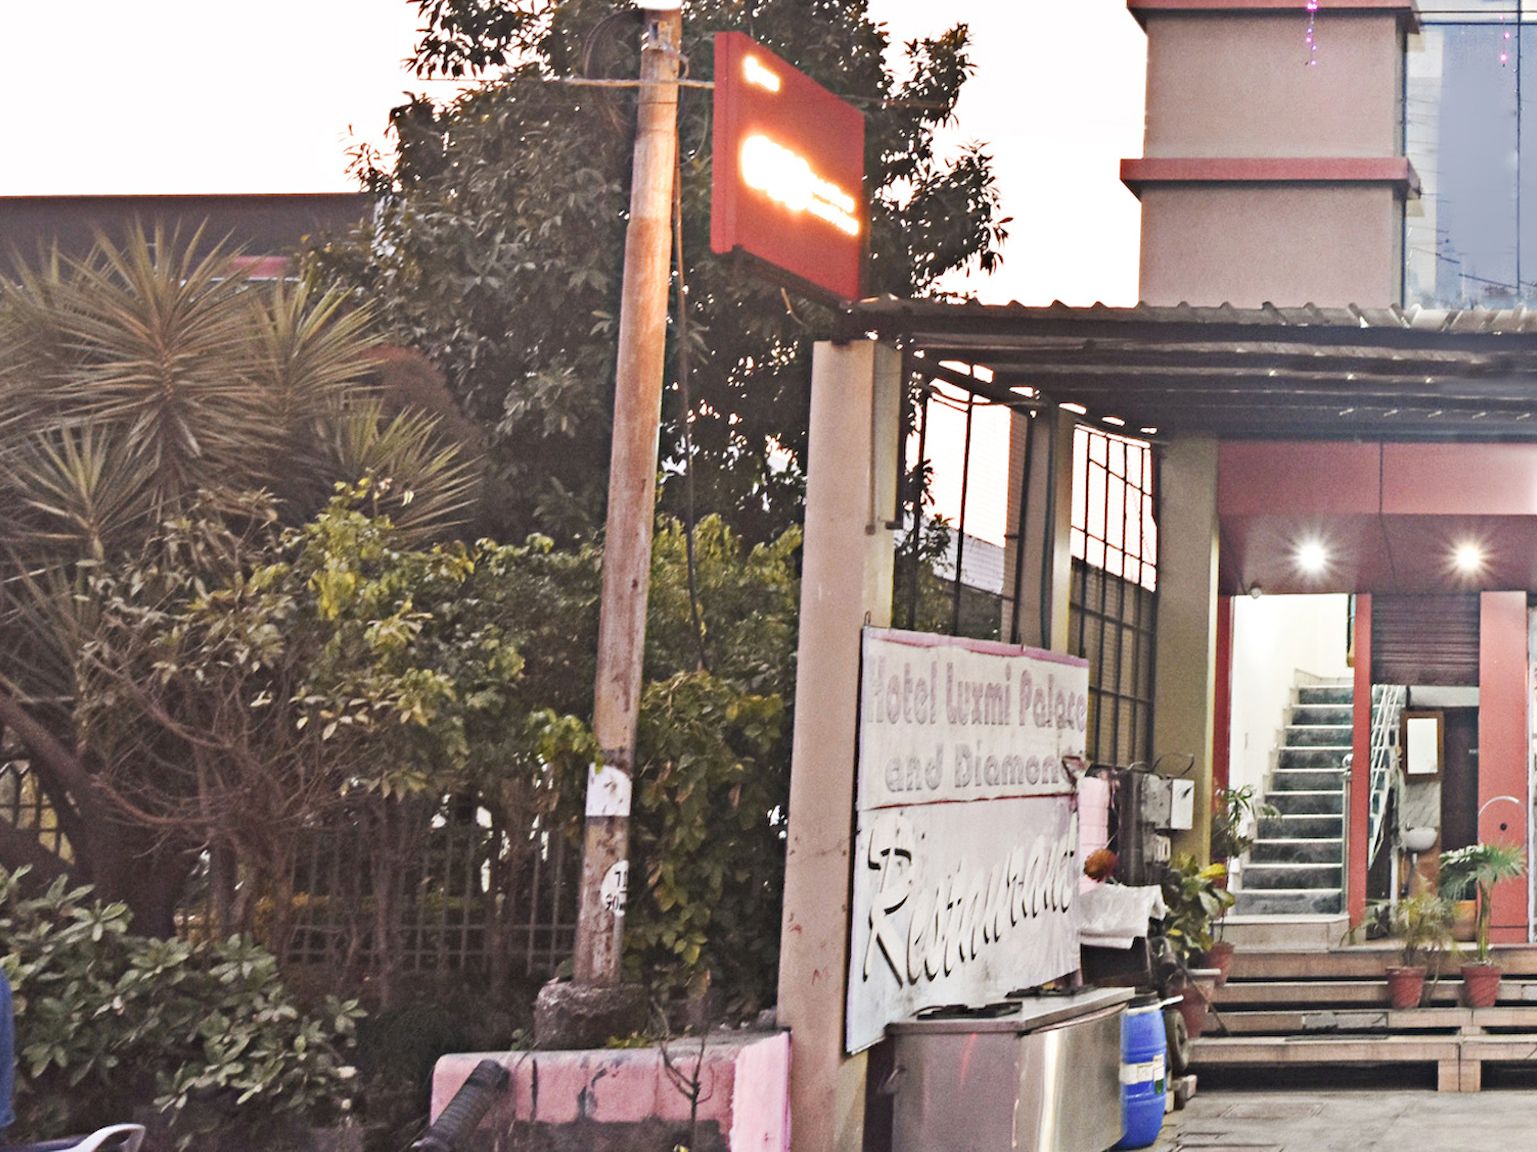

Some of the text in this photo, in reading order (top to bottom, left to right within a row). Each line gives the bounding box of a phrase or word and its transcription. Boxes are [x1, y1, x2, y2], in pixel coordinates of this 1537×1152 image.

[868, 655, 1088, 733] Hotel Luxmi Palace
[884, 743, 944, 793] and
